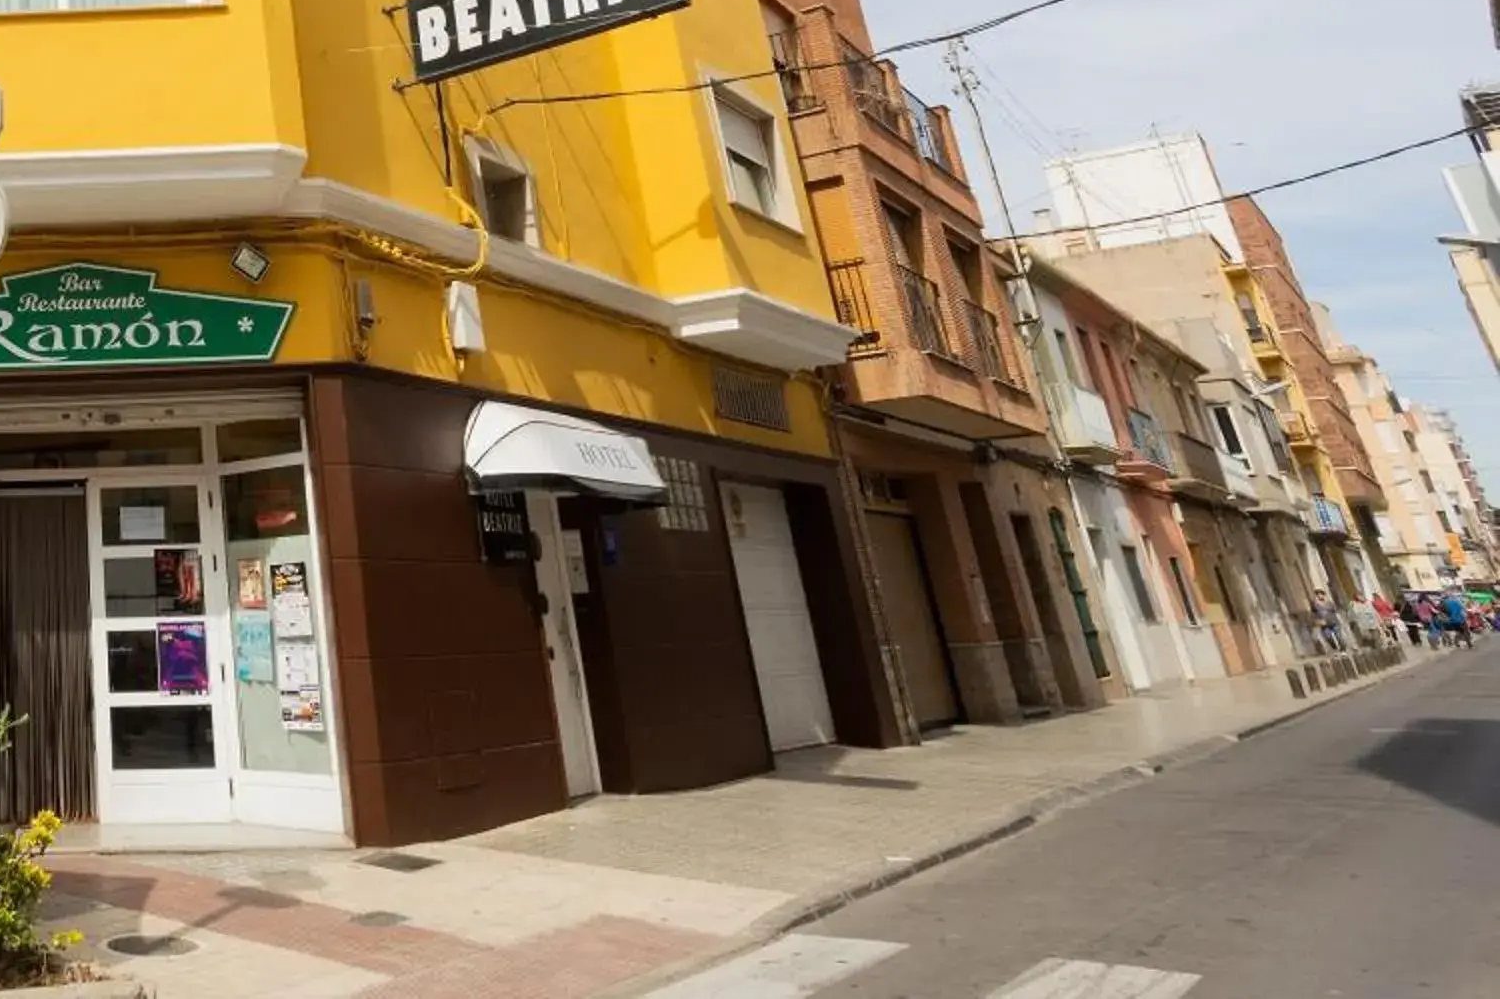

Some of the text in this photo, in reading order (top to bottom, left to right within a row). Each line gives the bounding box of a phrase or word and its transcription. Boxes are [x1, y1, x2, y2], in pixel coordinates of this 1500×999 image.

[57, 272, 104, 293] Bar
[16, 291, 148, 313] Restaurante
[574, 442, 638, 471] HOTEL
